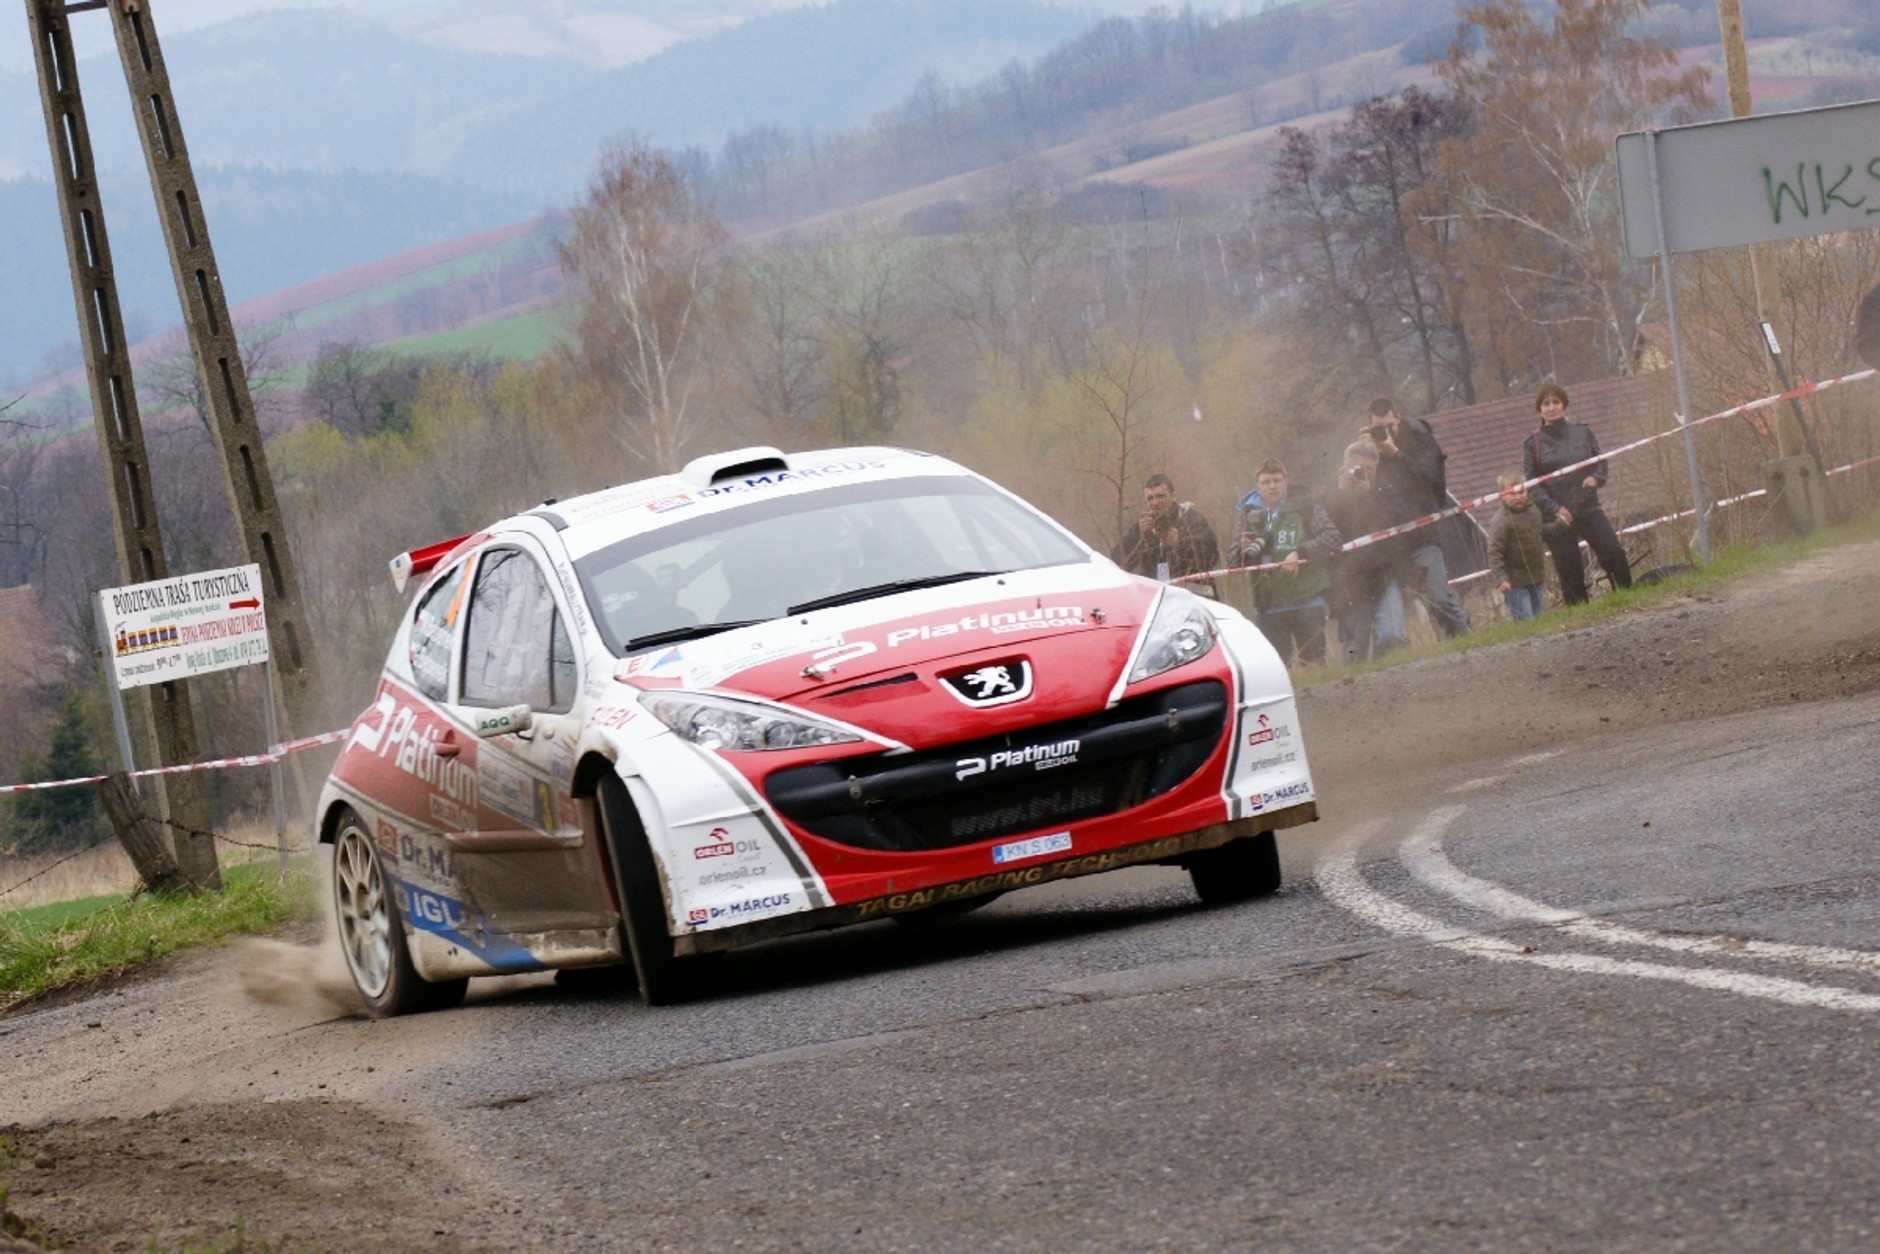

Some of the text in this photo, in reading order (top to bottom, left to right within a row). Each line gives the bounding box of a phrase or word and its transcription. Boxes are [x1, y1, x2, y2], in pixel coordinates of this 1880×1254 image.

[1278, 530, 1296, 544] 81
[113, 585, 166, 615] PODZIEMNA
[165, 582, 190, 607] TRASA
[887, 606, 1083, 647] Platinum
[481, 716, 511, 729] AQQ
[990, 740, 1080, 770] Platinum
[1275, 783, 1310, 799] MARCUS
[735, 840, 760, 853] OIL
[730, 893, 791, 914] MARCUS
